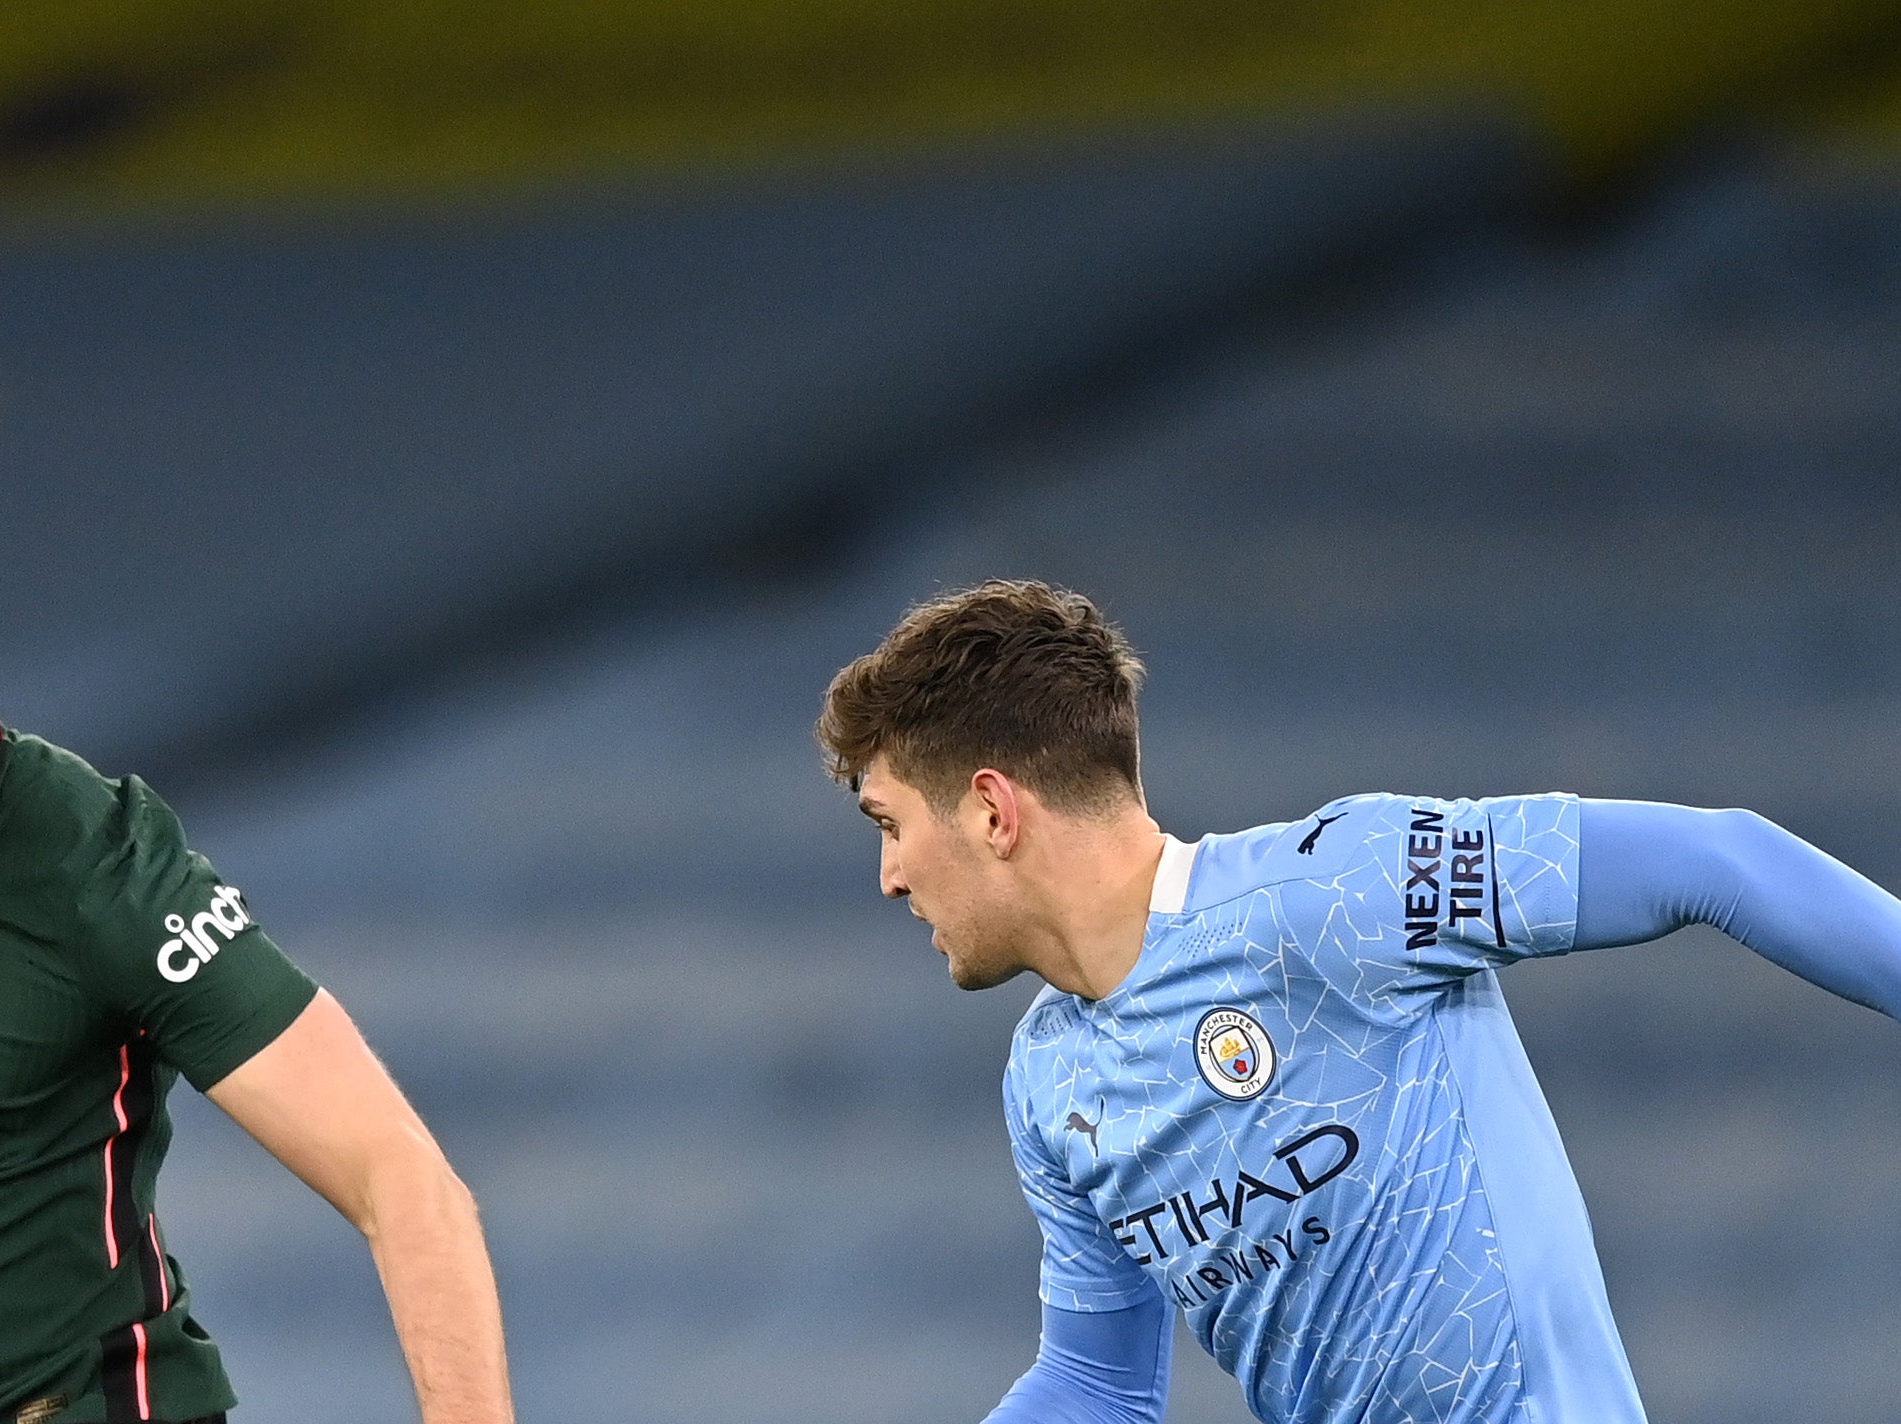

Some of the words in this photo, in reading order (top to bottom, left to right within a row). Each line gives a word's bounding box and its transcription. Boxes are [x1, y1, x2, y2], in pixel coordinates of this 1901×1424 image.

[1405, 808, 1445, 951] NEXEN
[1448, 827, 1485, 927] TIRE
[1200, 1013, 1253, 1055] MANCHESTER
[1240, 1078, 1262, 1095] CITY
[1170, 1216, 1331, 1309] AIRWAYS
